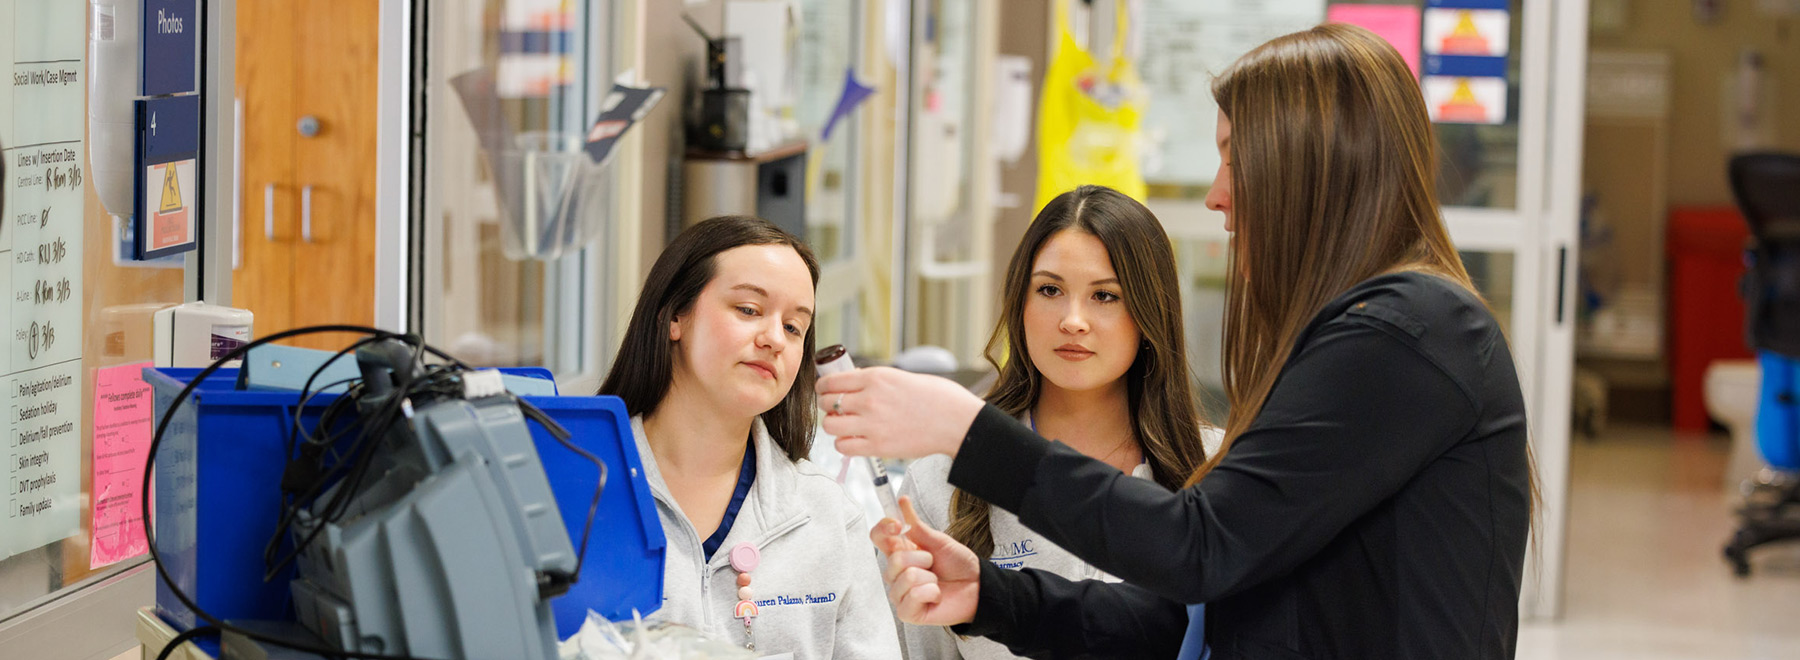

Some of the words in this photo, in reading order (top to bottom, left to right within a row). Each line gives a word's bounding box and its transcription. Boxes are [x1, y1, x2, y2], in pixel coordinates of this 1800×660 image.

[158, 8, 183, 34] Photos
[14, 72, 29, 86] Social
[30, 69, 58, 87] Work/Case
[150, 111, 157, 136] 4
[18, 153, 31, 167] Lines
[32, 150, 40, 167] w/
[41, 149, 63, 164] Insertion
[64, 148, 75, 162] Date
[46, 168, 52, 192] R
[69, 164, 82, 190] 3/13
[35, 280, 41, 304] R
[57, 277, 71, 303] 3/13
[19, 374, 72, 397] Pain/agitation/delirium
[19, 406, 40, 421] Sedation
[41, 400, 57, 415] holiday
[19, 425, 48, 446] Delirium/fall
[49, 421, 73, 439] prevention
[19, 456, 29, 469] Skin
[30, 450, 49, 467] integrity
[19, 479, 29, 493] DVT
[30, 471, 56, 493] prophylaxis
[20, 501, 35, 517] Family
[36, 497, 52, 514] update
[805, 592, 836, 604] PharmD
